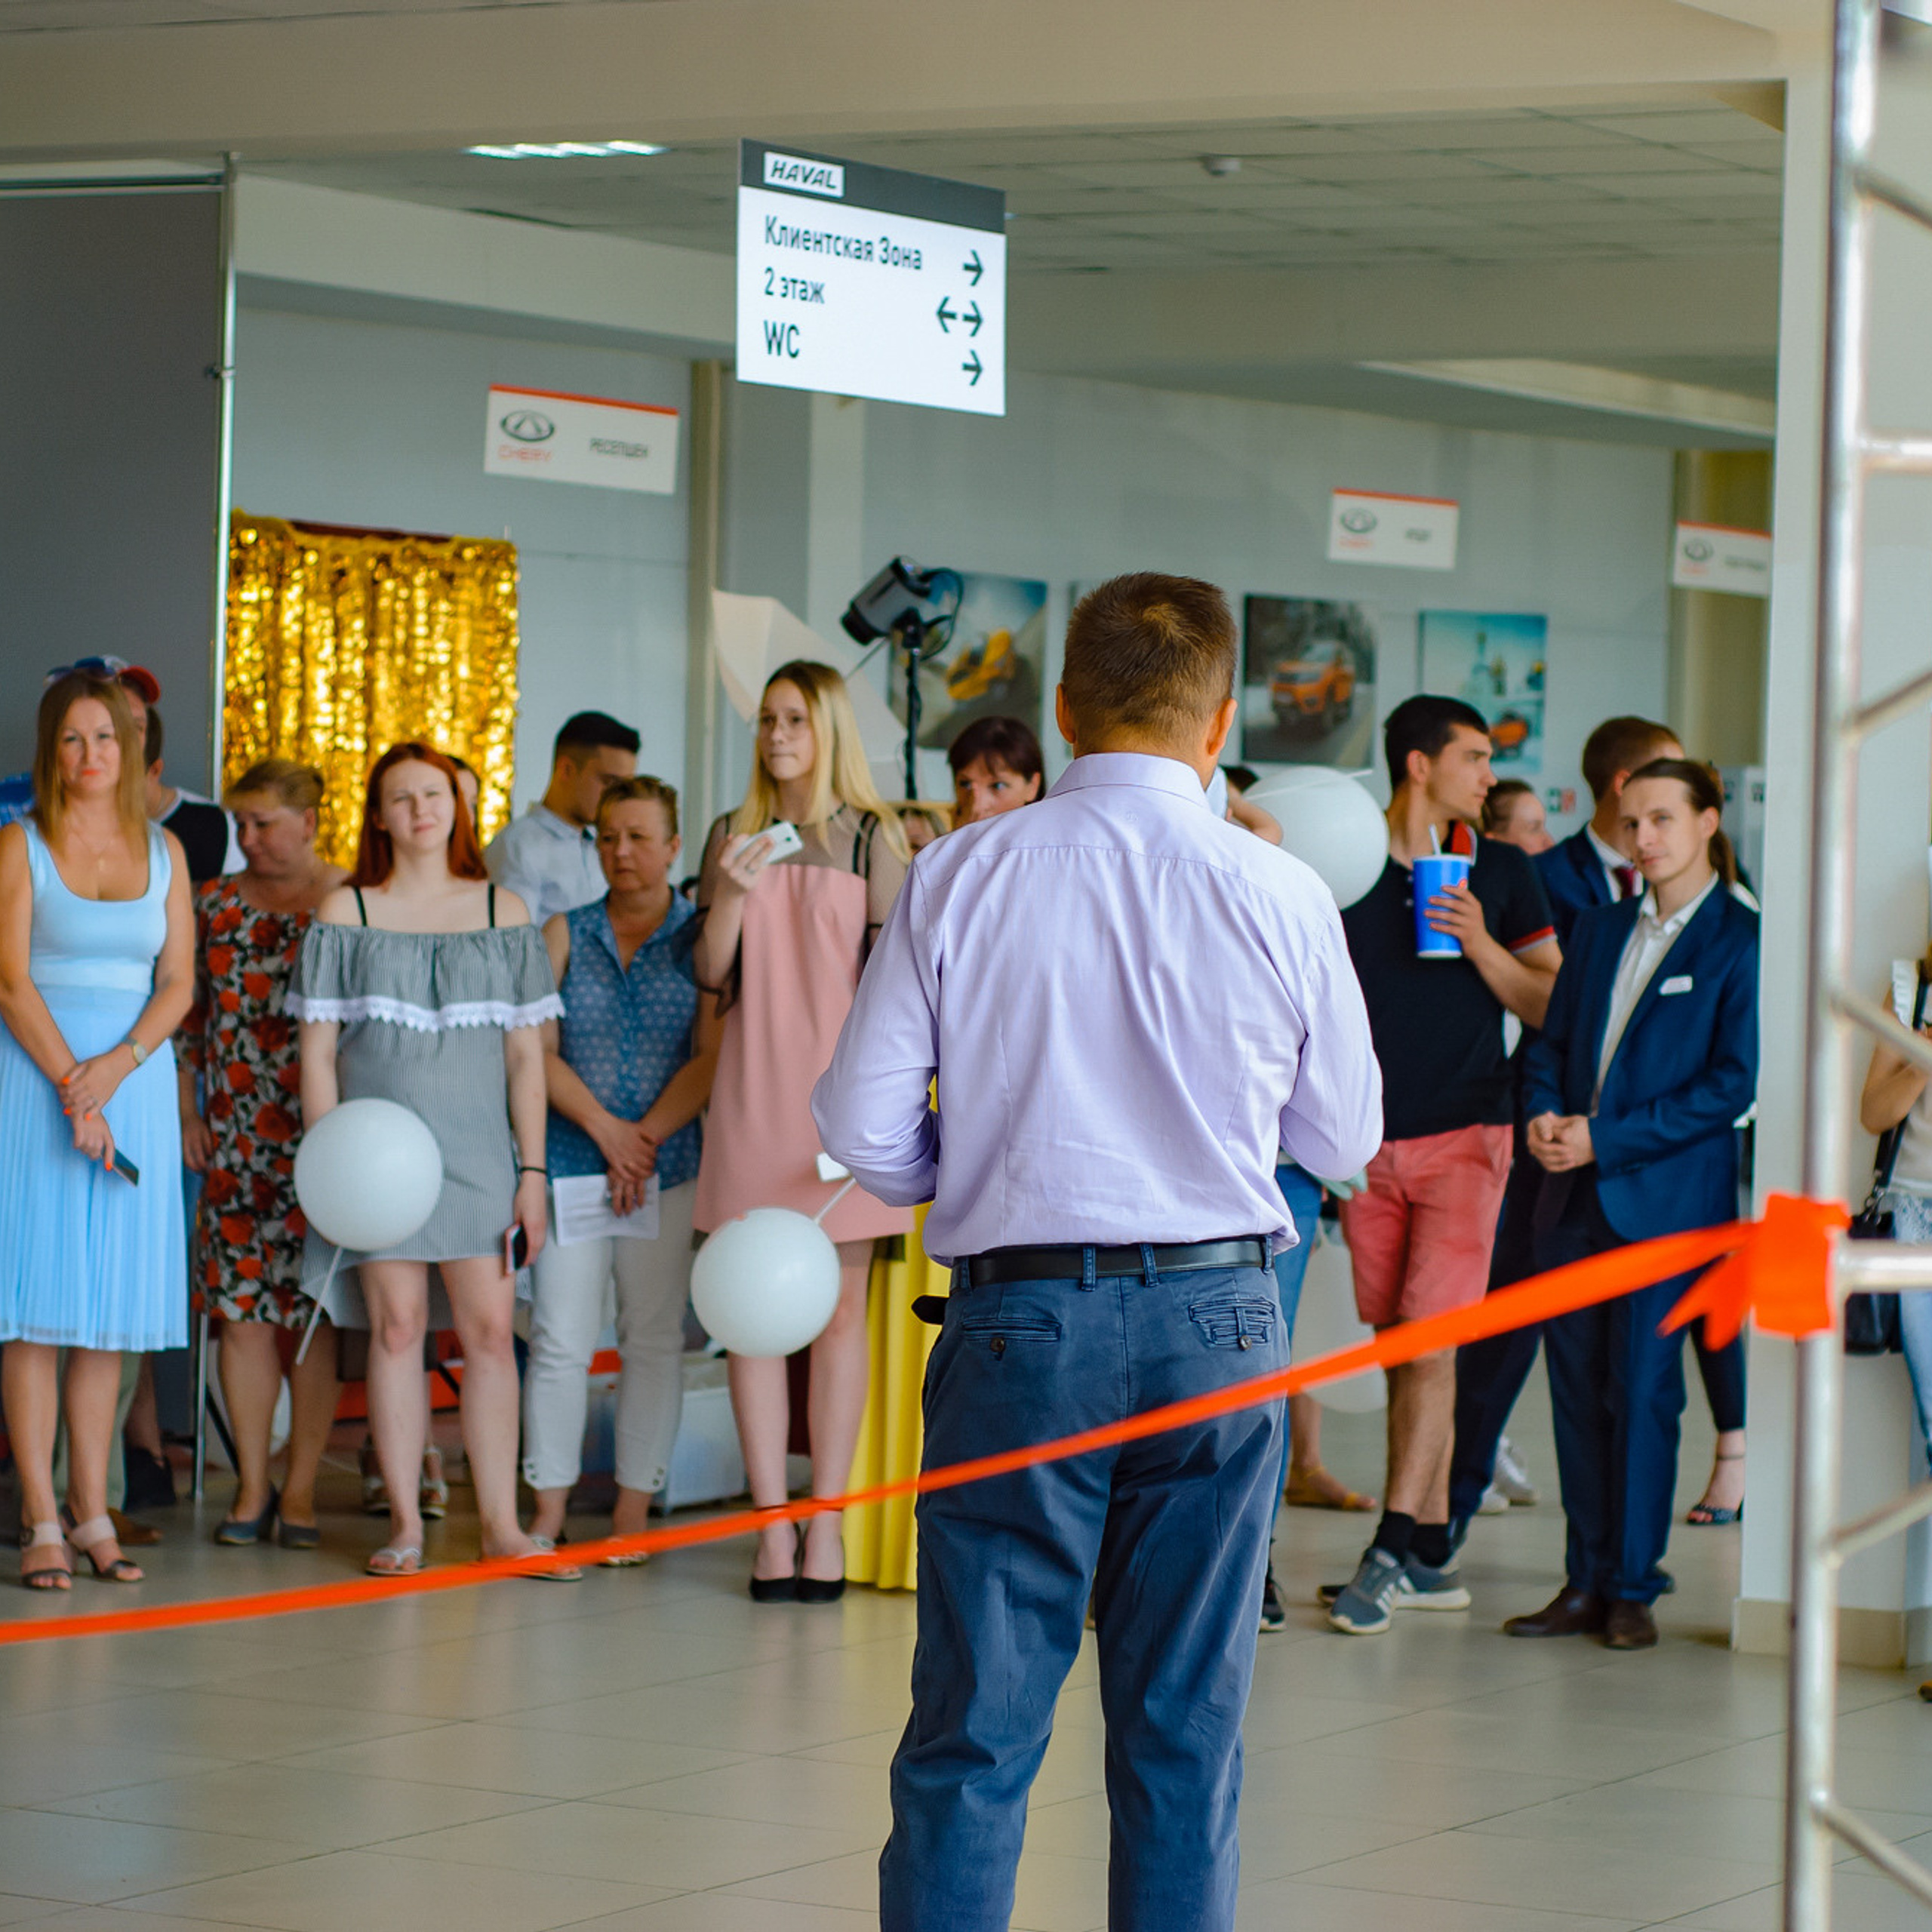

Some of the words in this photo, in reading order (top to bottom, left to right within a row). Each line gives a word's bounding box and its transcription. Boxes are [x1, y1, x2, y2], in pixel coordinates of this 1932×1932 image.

[771, 160, 837, 189] HAVAL
[765, 214, 874, 262] Клиентская
[878, 236, 922, 270] Зона
[764, 266, 775, 297] 2
[780, 276, 826, 304] этаж
[763, 319, 801, 358] WC
